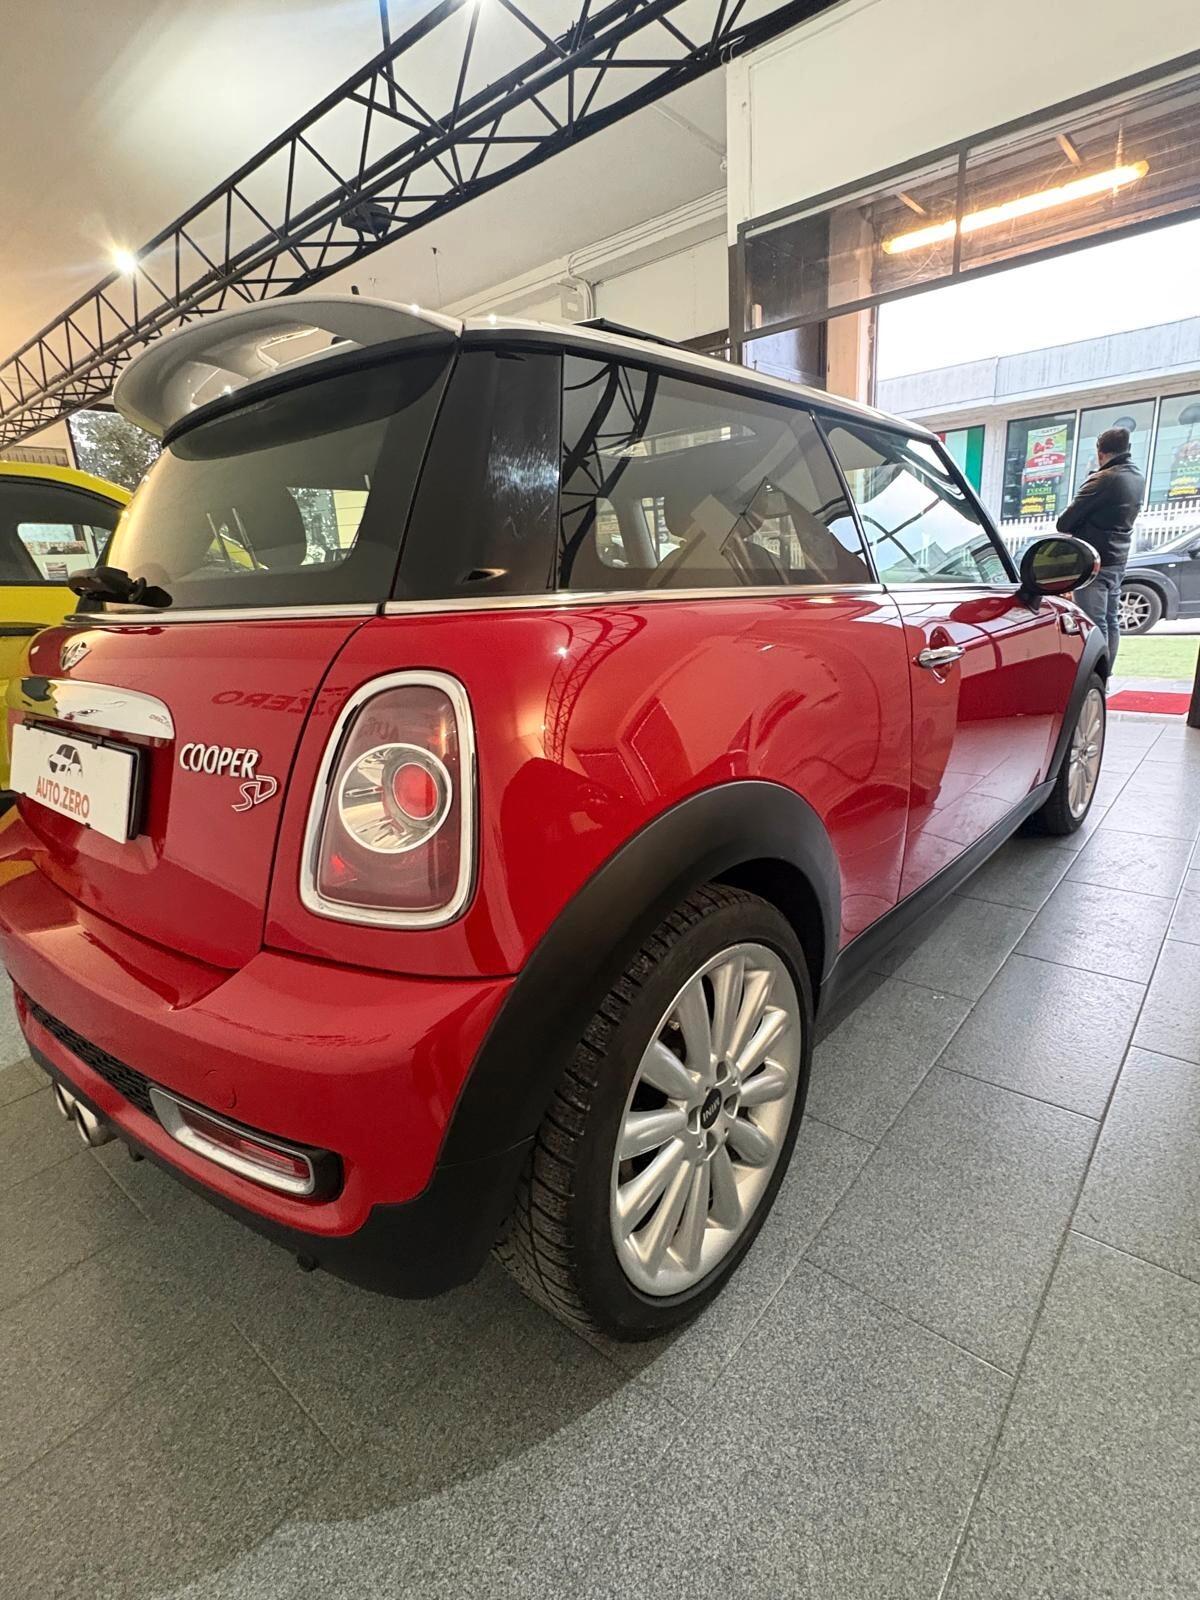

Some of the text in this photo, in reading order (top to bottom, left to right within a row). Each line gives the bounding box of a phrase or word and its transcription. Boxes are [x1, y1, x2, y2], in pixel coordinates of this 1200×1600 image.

[179, 743, 259, 779] COOPER
[35, 775, 91, 819] AUTO.ZERO
[231, 774, 278, 812] SD
[702, 1096, 721, 1123] MINI
